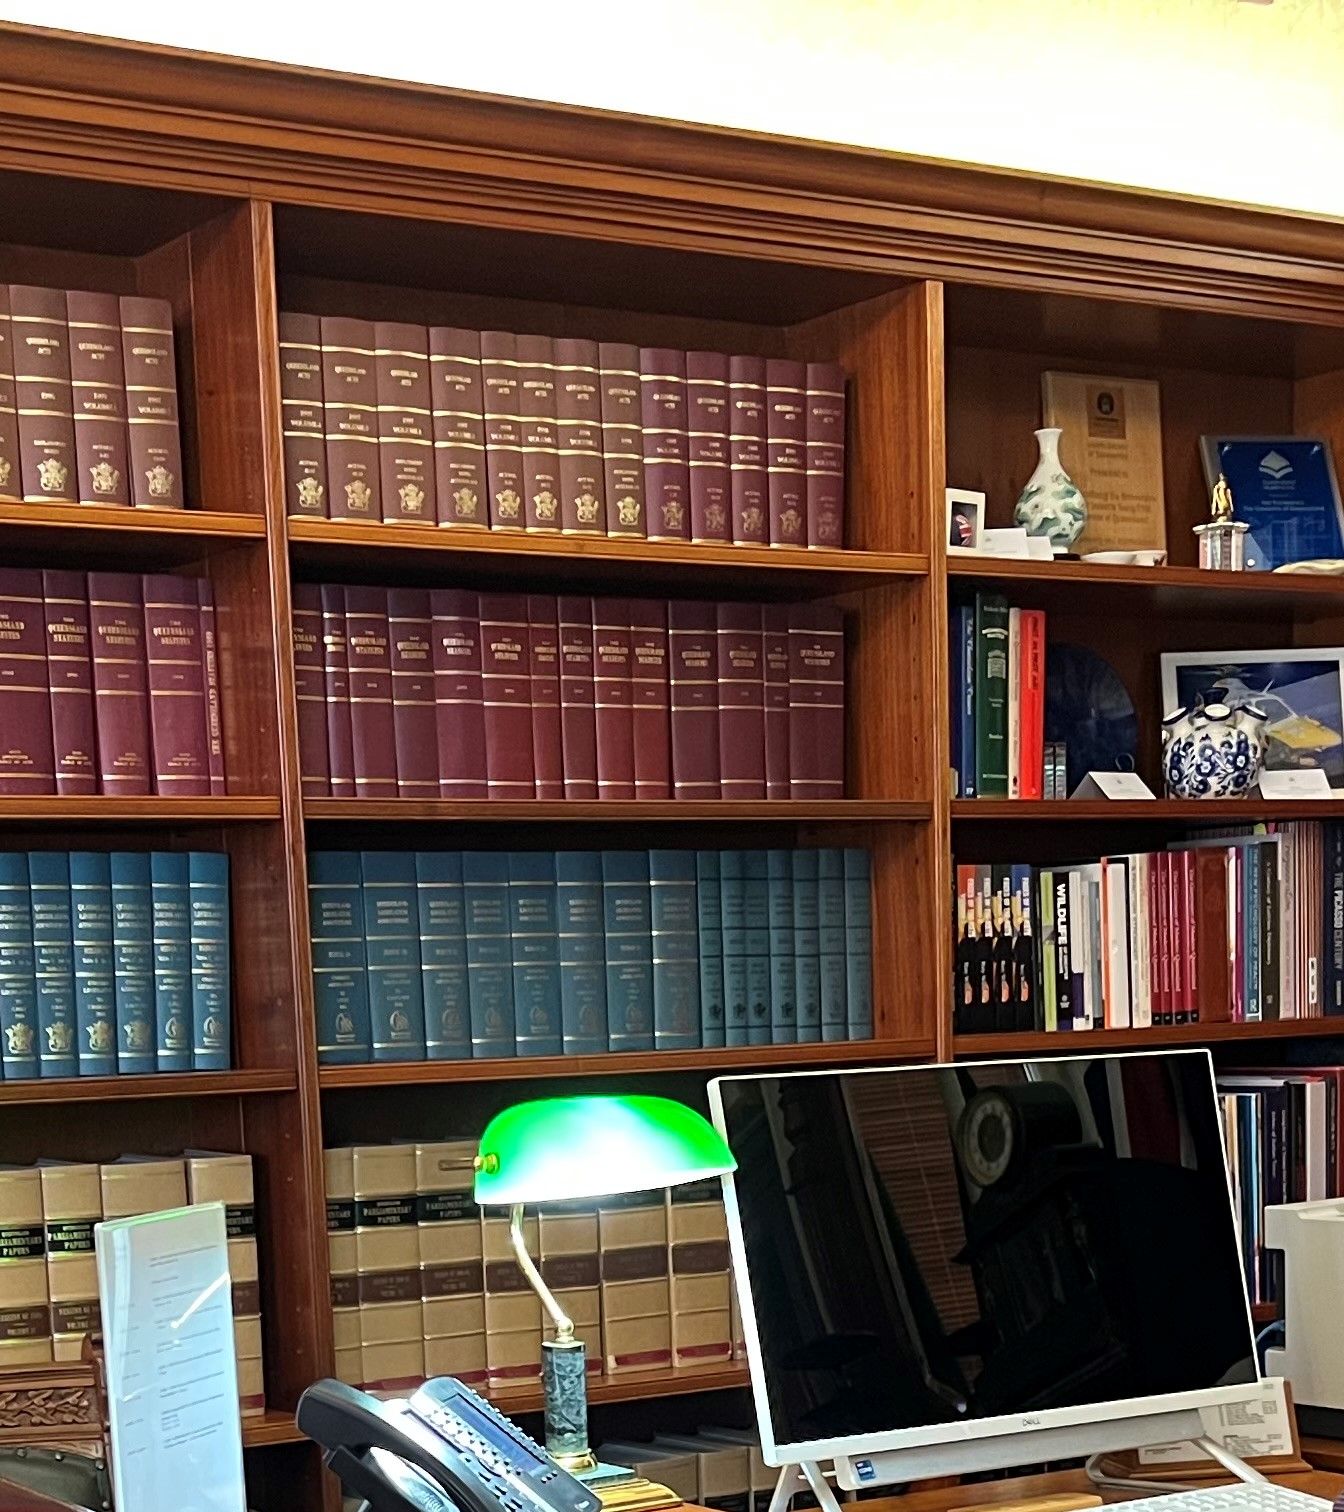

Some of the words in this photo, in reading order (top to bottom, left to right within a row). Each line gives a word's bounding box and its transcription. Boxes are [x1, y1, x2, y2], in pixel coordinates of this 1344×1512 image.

[48, 623, 87, 634] QUEENSLAND
[98, 626, 139, 637] QUEENSLAND
[153, 627, 194, 638] QUEENSLAND
[53, 634, 84, 644] STATUTES
[106, 635, 136, 646] STATUTES
[160, 637, 191, 646] STATUTES
[1334, 872, 1343, 889] THE
[1056, 883, 1068, 945] WILDLIFE
[1333, 890, 1343, 929] PICASSO
[1333, 929, 1343, 970] CENTURY
[64, 1240, 91, 1250] PAPERS
[3, 1247, 30, 1256] PAPERS
